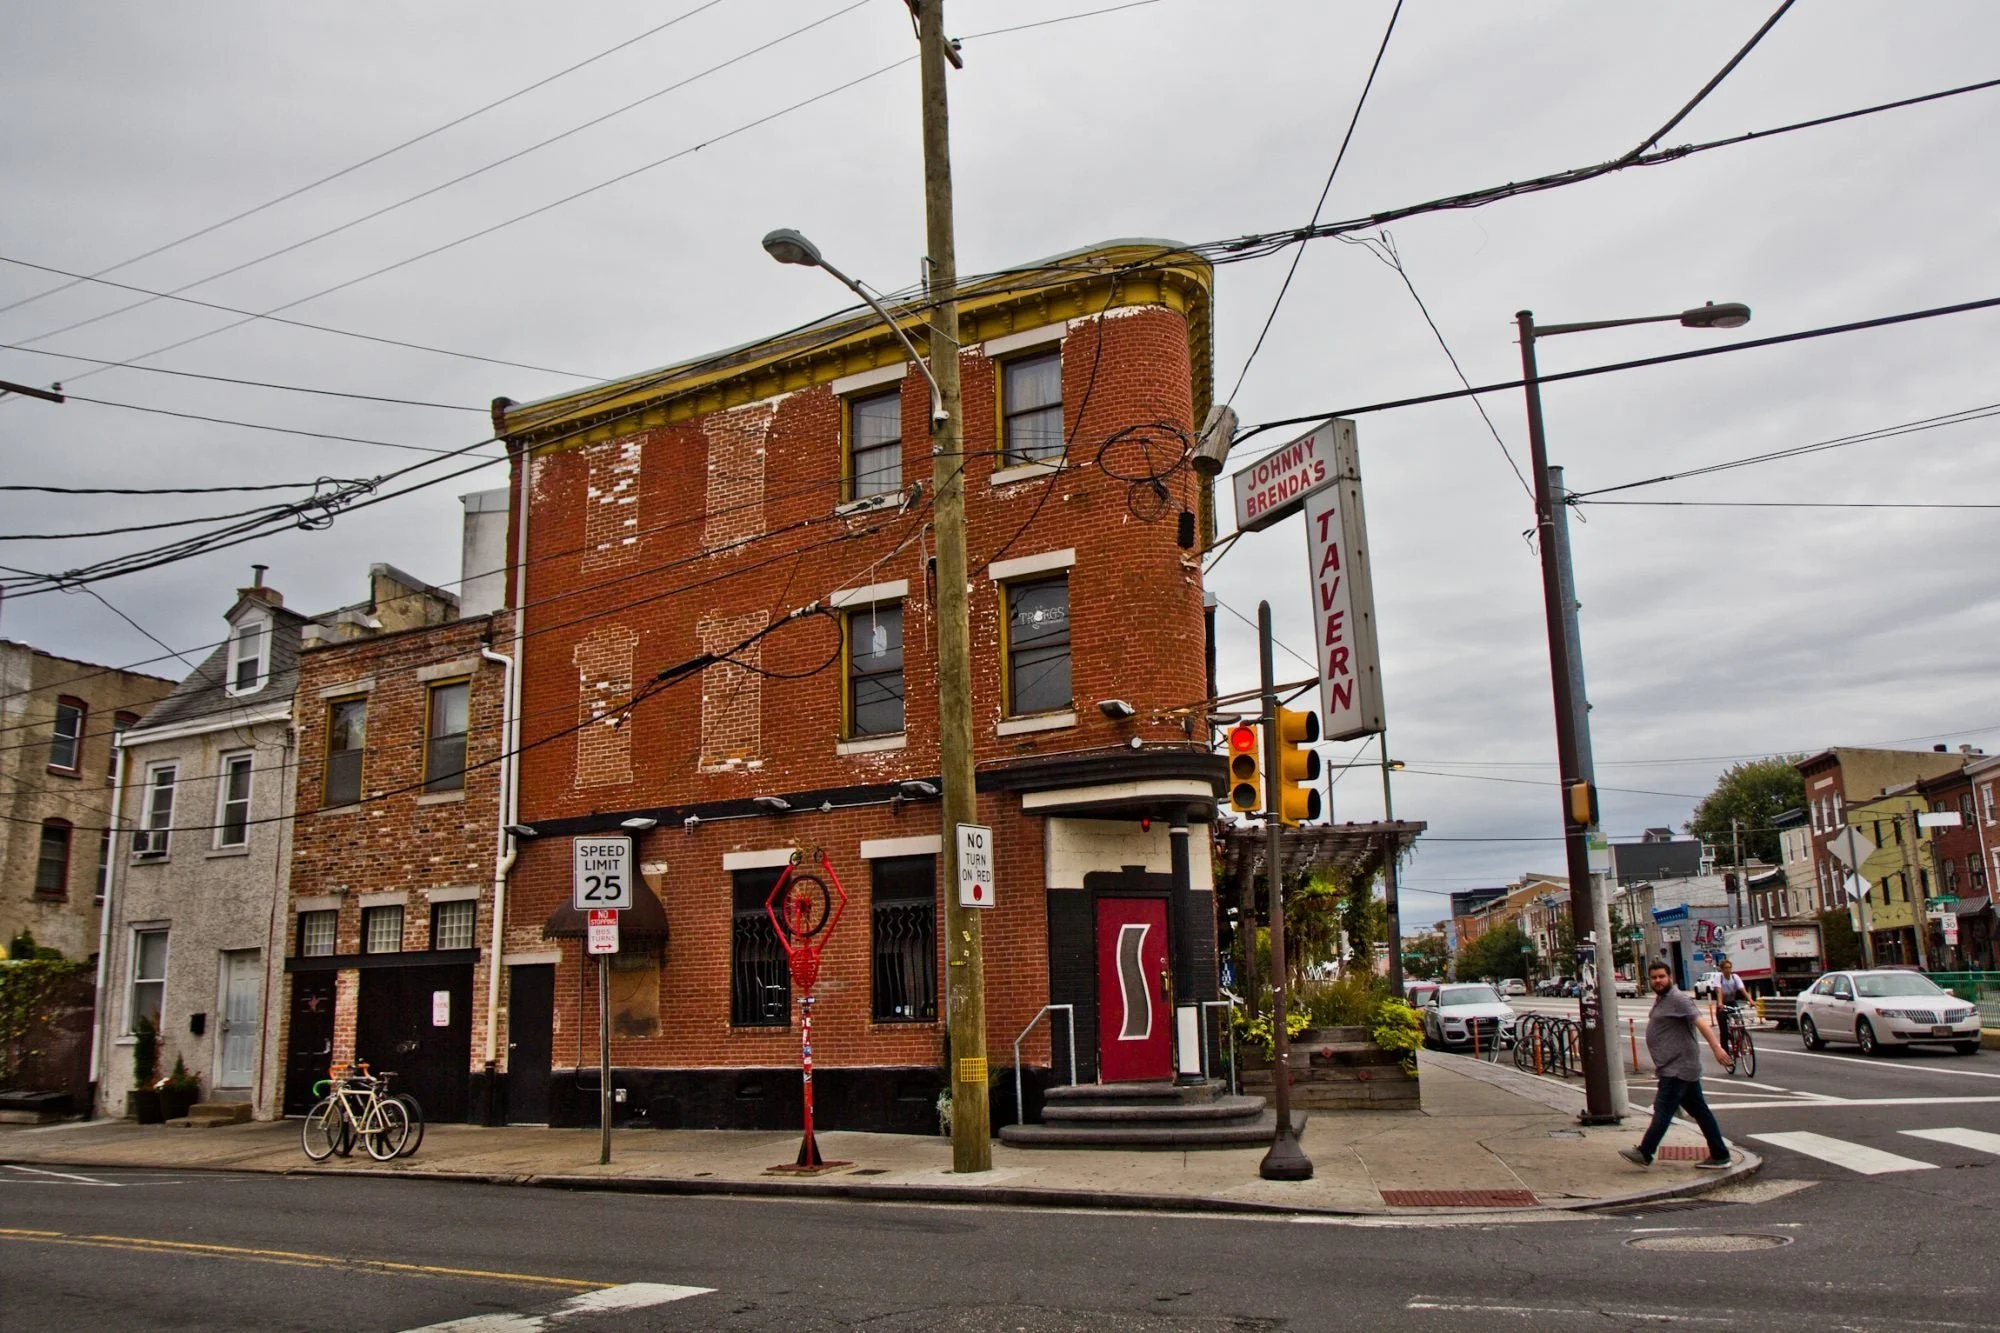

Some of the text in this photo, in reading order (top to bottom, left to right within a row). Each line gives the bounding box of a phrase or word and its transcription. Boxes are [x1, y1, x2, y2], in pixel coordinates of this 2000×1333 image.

[1248, 436, 1316, 491] JOHNNY
[1246, 459, 1326, 518] BRENDA'S
[1316, 508, 1354, 715] TAVERN
[967, 833, 983, 849] NO
[580, 846, 625, 857] SPEED
[585, 860, 620, 871] LIMIT
[966, 852, 986, 866] TURN
[962, 869, 991, 882] ON RED
[584, 876, 622, 901] 25
[597, 911, 609, 919] NO
[1944, 921, 1956, 929] 30
